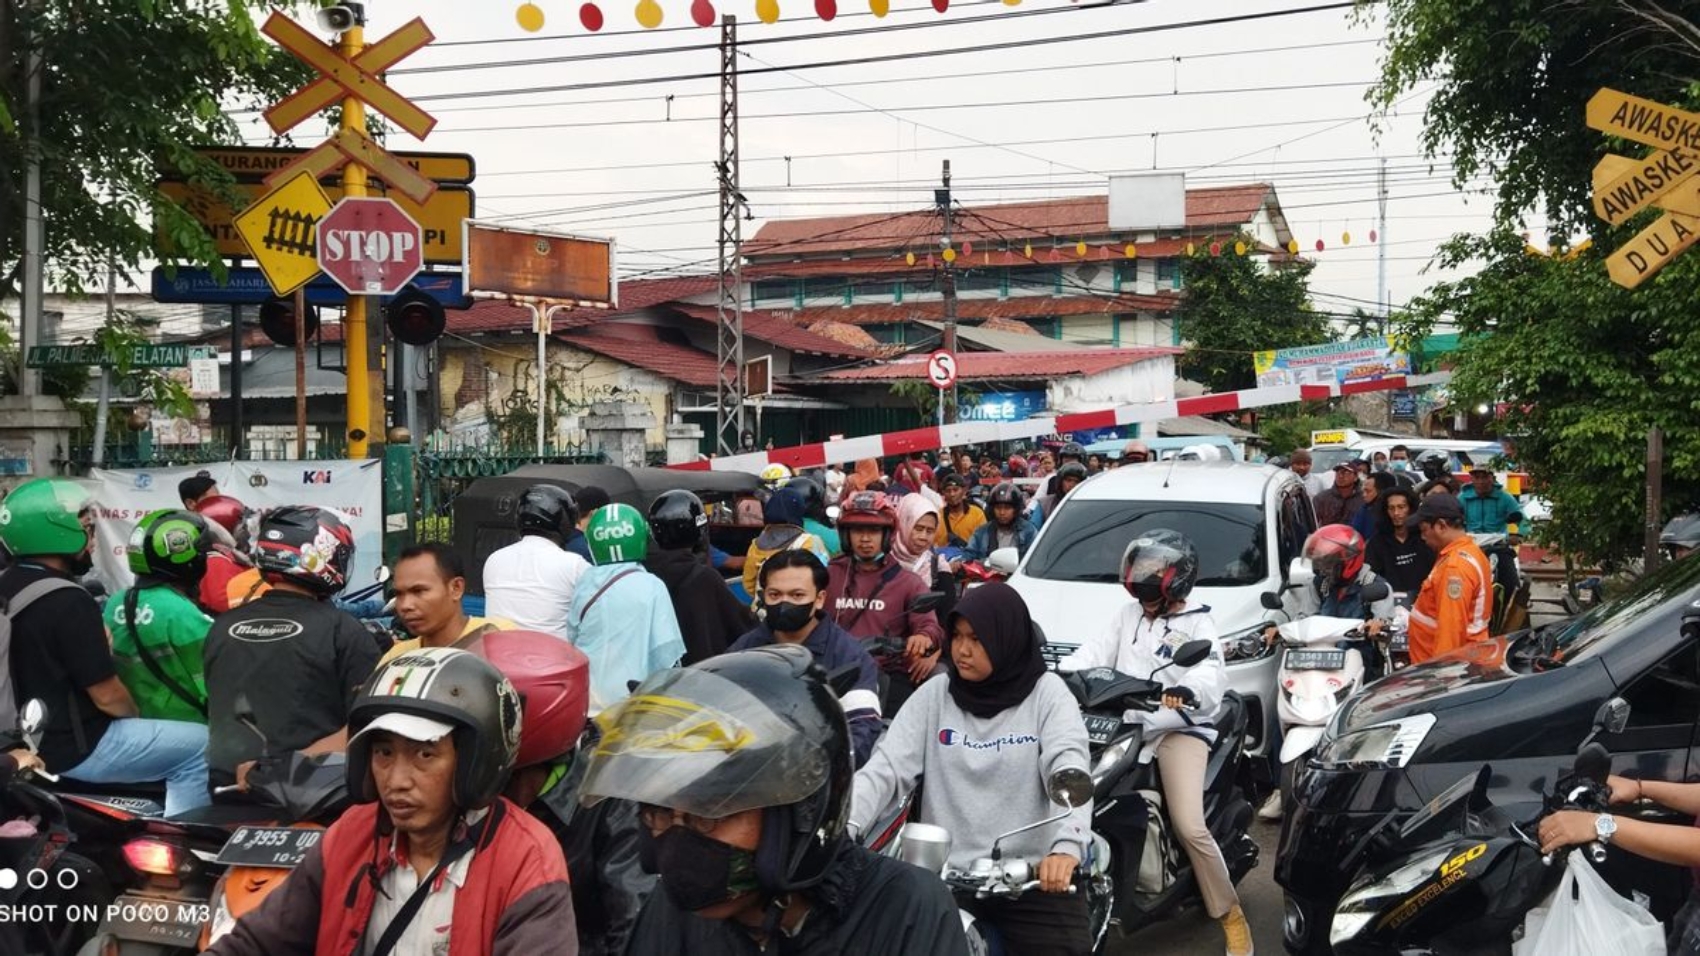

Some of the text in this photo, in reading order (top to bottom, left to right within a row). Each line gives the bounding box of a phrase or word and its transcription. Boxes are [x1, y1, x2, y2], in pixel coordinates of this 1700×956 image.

[1609, 101, 1700, 151] AWASKE
[1602, 146, 1693, 221] AWASKE
[325, 229, 414, 262] STOP
[126, 347, 184, 365] SELATAN
[593, 520, 635, 541] Grab
[939, 729, 1037, 752] Champion
[232, 829, 249, 844] B
[250, 830, 291, 846] 3955
[1440, 843, 1487, 877] 150
